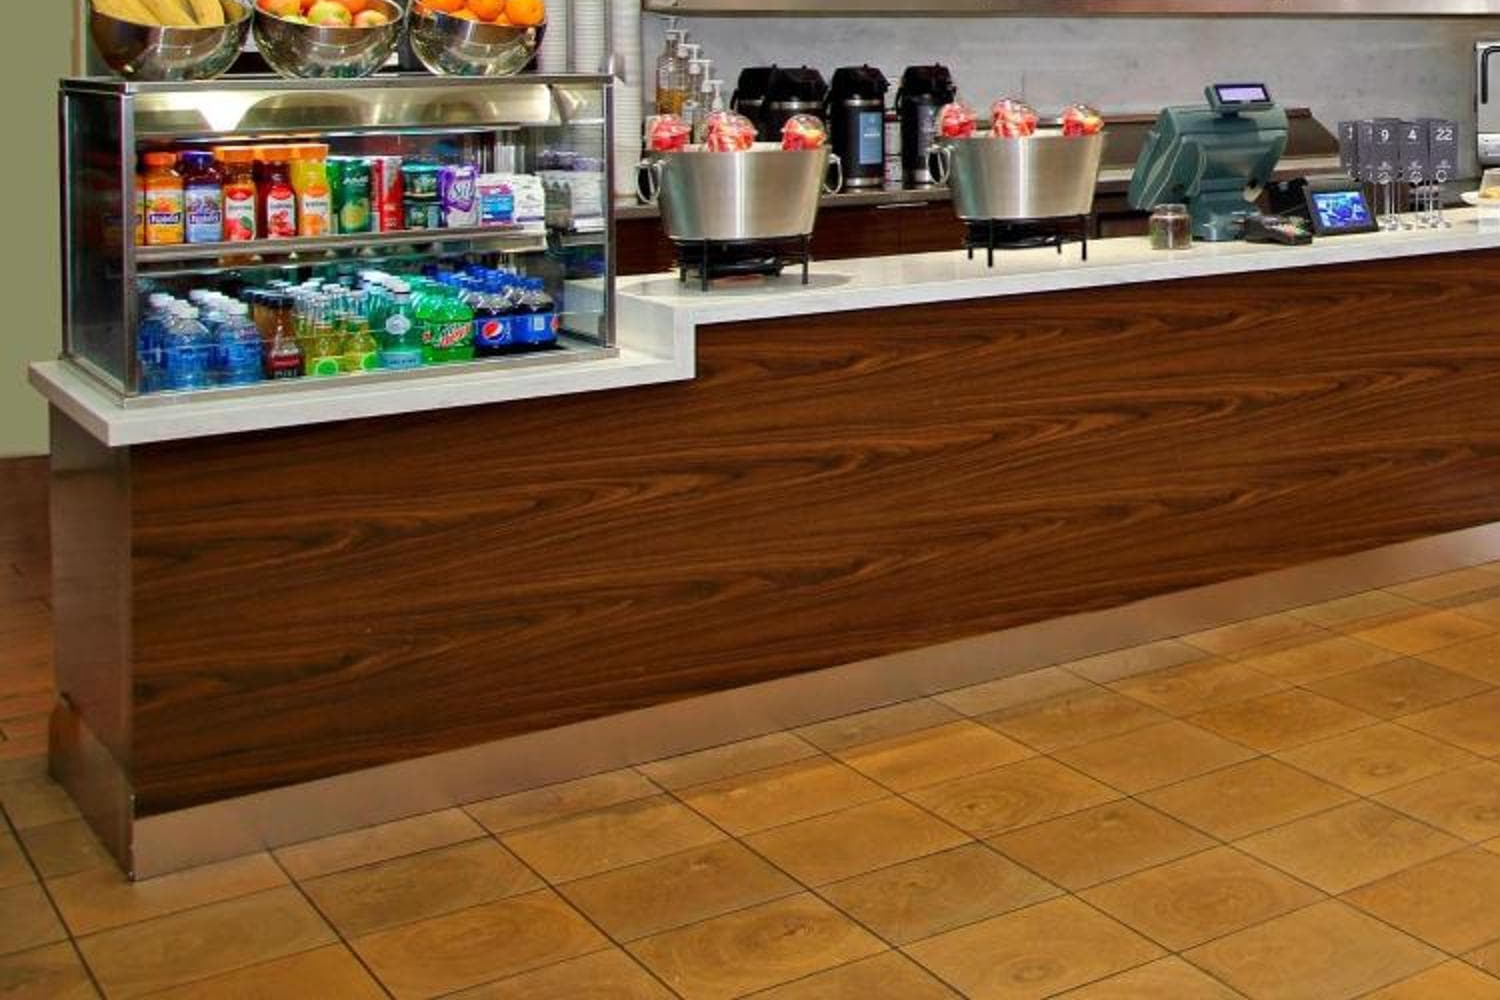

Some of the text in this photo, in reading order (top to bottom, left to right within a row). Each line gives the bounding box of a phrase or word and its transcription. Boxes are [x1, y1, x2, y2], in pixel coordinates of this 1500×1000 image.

[1381, 129, 1390, 142] 9
[1408, 129, 1417, 140] 4
[1436, 128, 1453, 141] 22
